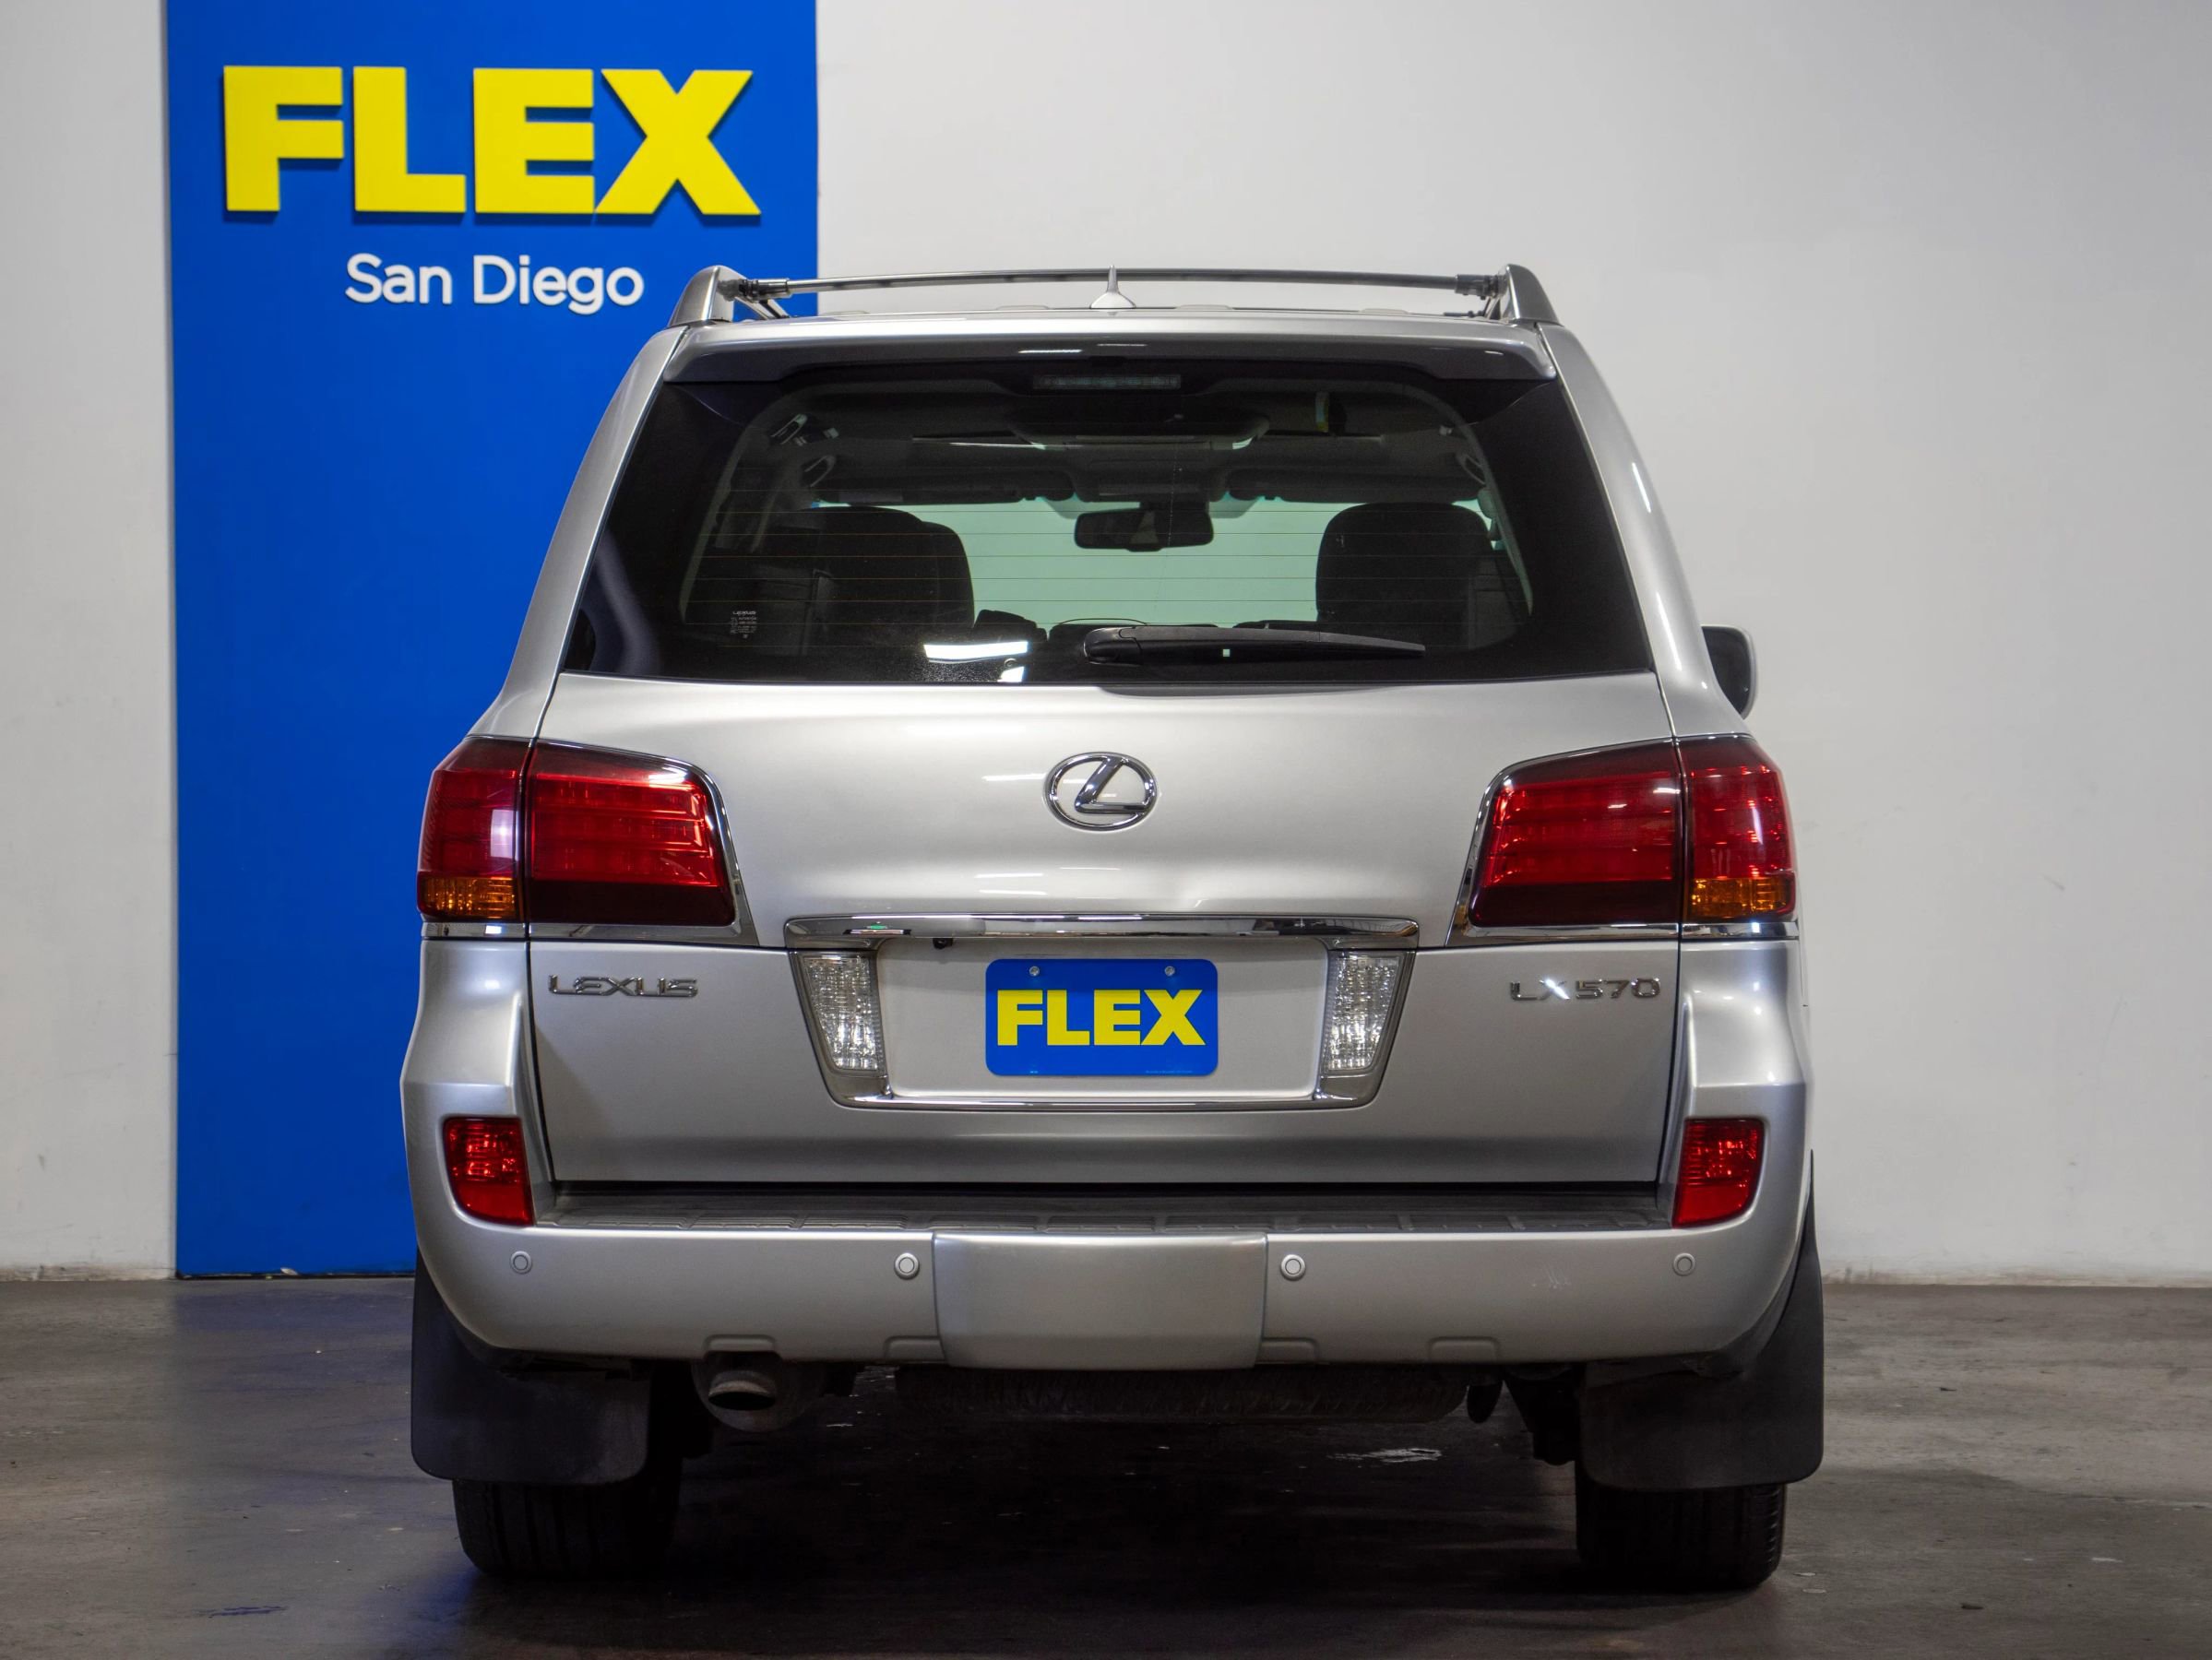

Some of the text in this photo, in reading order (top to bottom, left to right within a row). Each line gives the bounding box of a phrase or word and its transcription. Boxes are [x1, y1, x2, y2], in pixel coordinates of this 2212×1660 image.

[223, 65, 761, 215] FLEX
[345, 253, 645, 314] San Diego
[548, 974, 698, 998] LEXUS
[1510, 977, 1660, 1001] LX 570
[997, 990, 1206, 1046] FLEX
